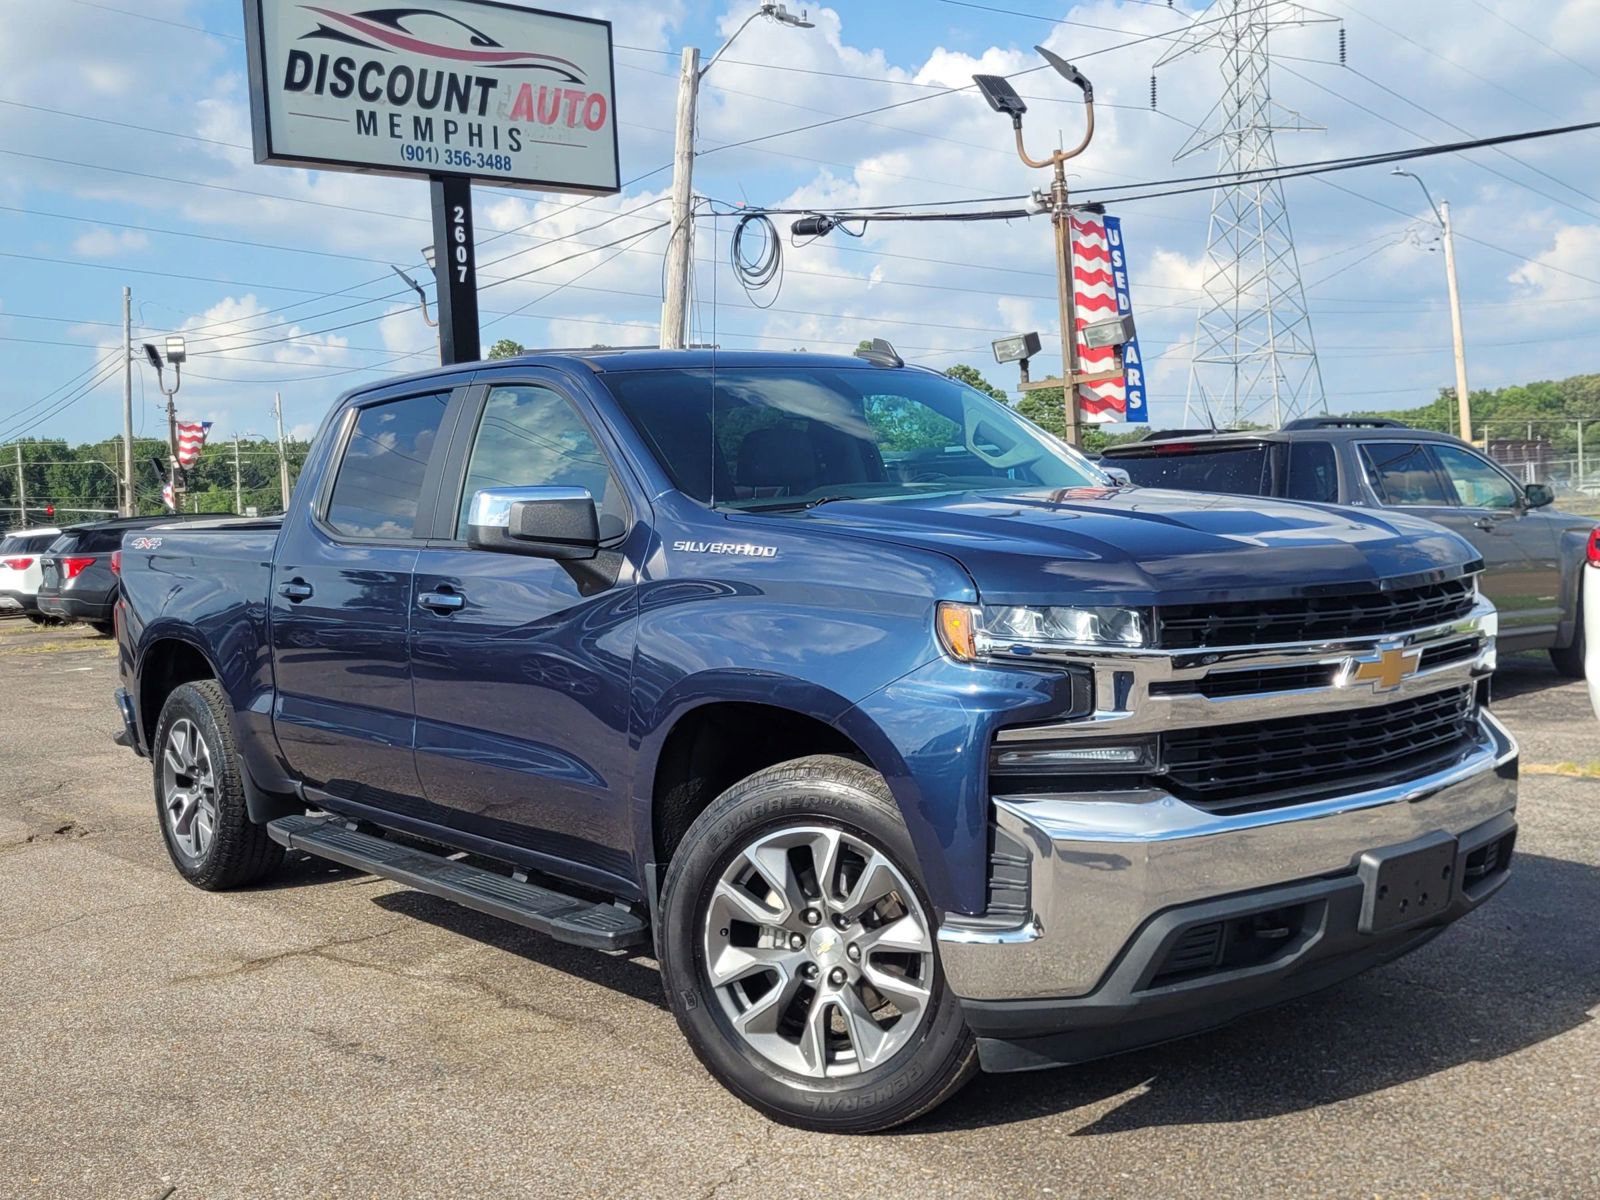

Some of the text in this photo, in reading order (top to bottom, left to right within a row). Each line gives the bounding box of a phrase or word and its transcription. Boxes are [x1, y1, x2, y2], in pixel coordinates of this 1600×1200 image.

[283, 48, 608, 131] DISCOUNT AUTO
[356, 109, 523, 153] MEMPHIS
[400, 143, 513, 172] (901) 356-3488
[453, 206, 468, 284] 2607
[1107, 229, 1142, 410] USED ARS
[672, 540, 779, 558] SILVERADO
